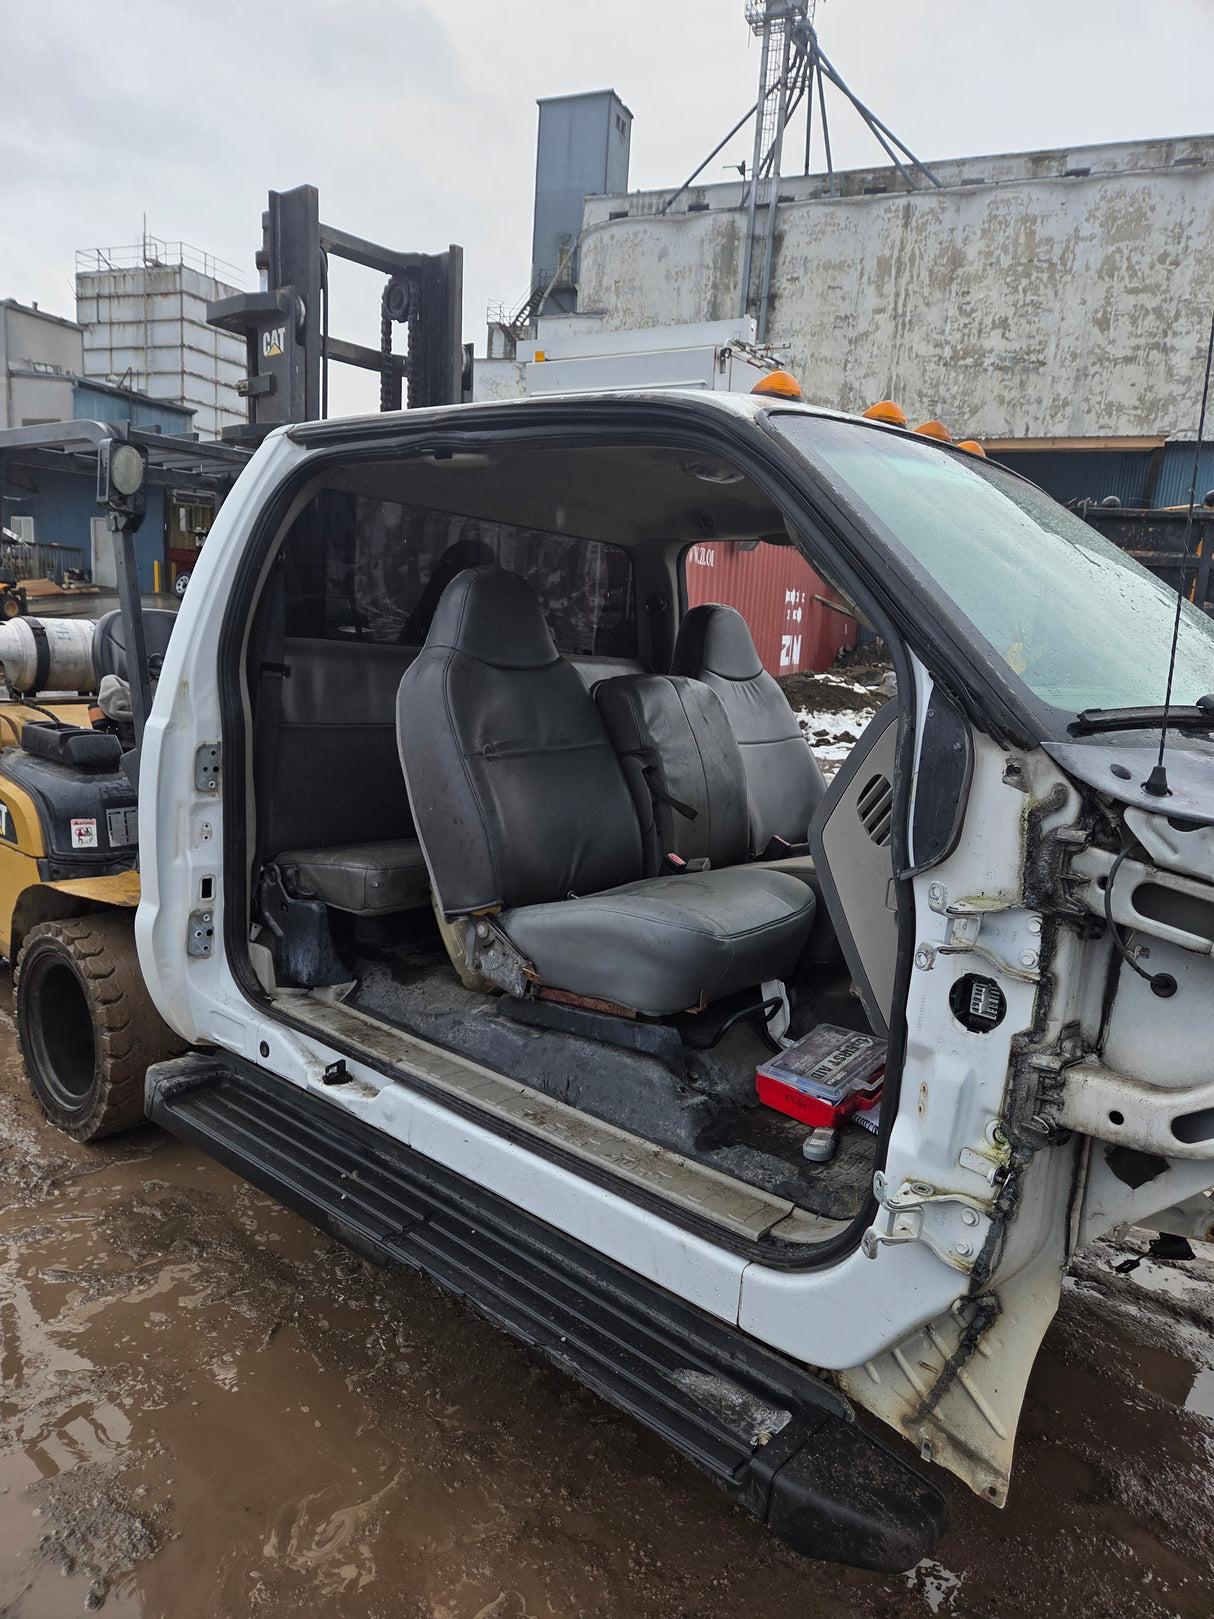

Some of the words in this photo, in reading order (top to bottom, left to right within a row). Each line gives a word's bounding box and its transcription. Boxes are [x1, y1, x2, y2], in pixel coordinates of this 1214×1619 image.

[263, 327, 286, 357] CAT
[828, 1042, 860, 1067] FIRST
[810, 1065, 833, 1079] AID
